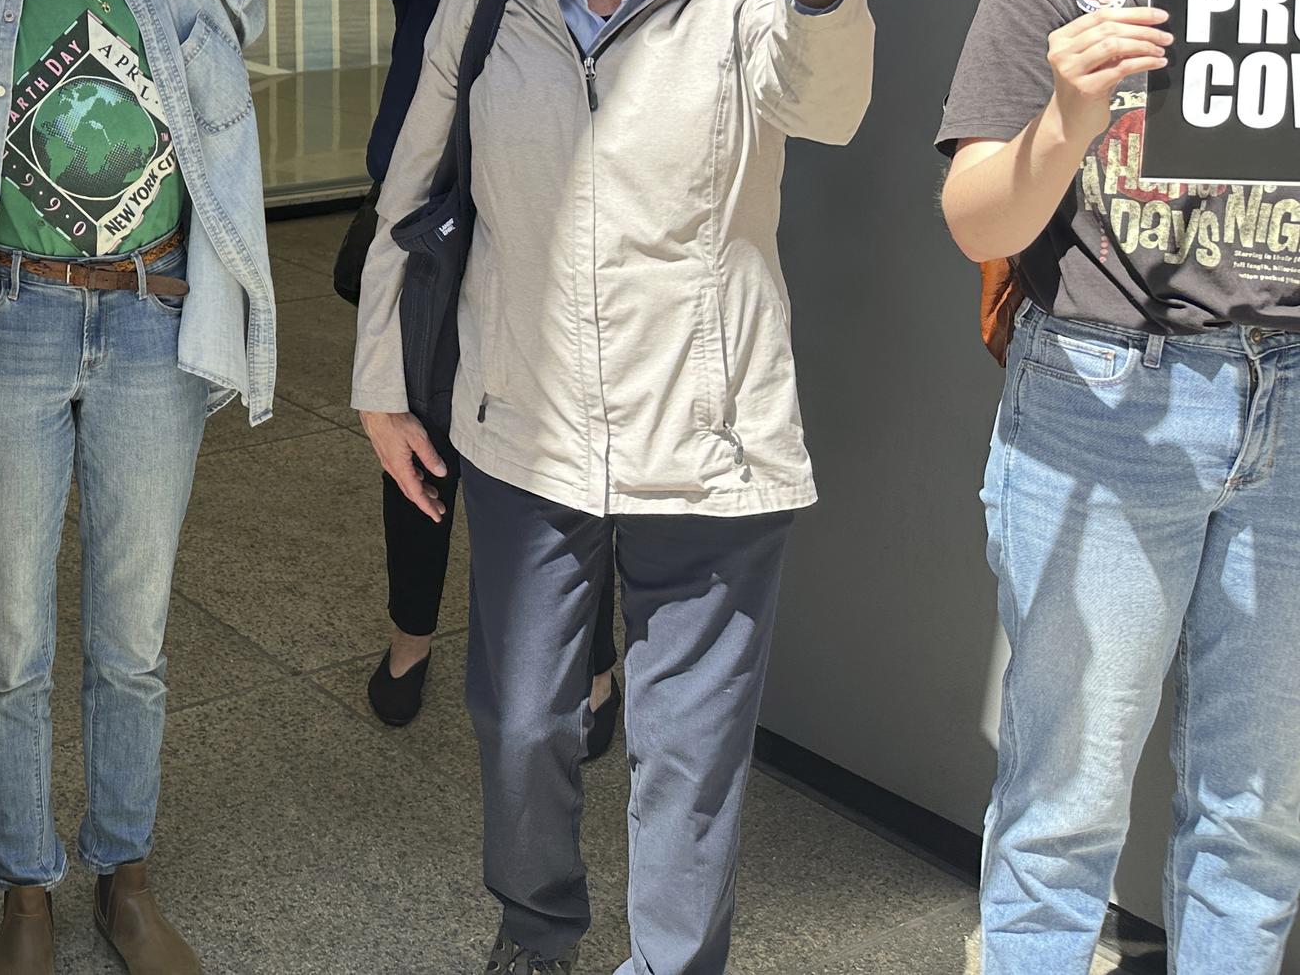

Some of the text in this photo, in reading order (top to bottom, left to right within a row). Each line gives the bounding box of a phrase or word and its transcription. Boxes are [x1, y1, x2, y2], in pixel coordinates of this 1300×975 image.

[8, 40, 82, 123] ARTH DAY
[98, 44, 151, 101] APRL
[103, 150, 176, 236] NEW YORK CIT
